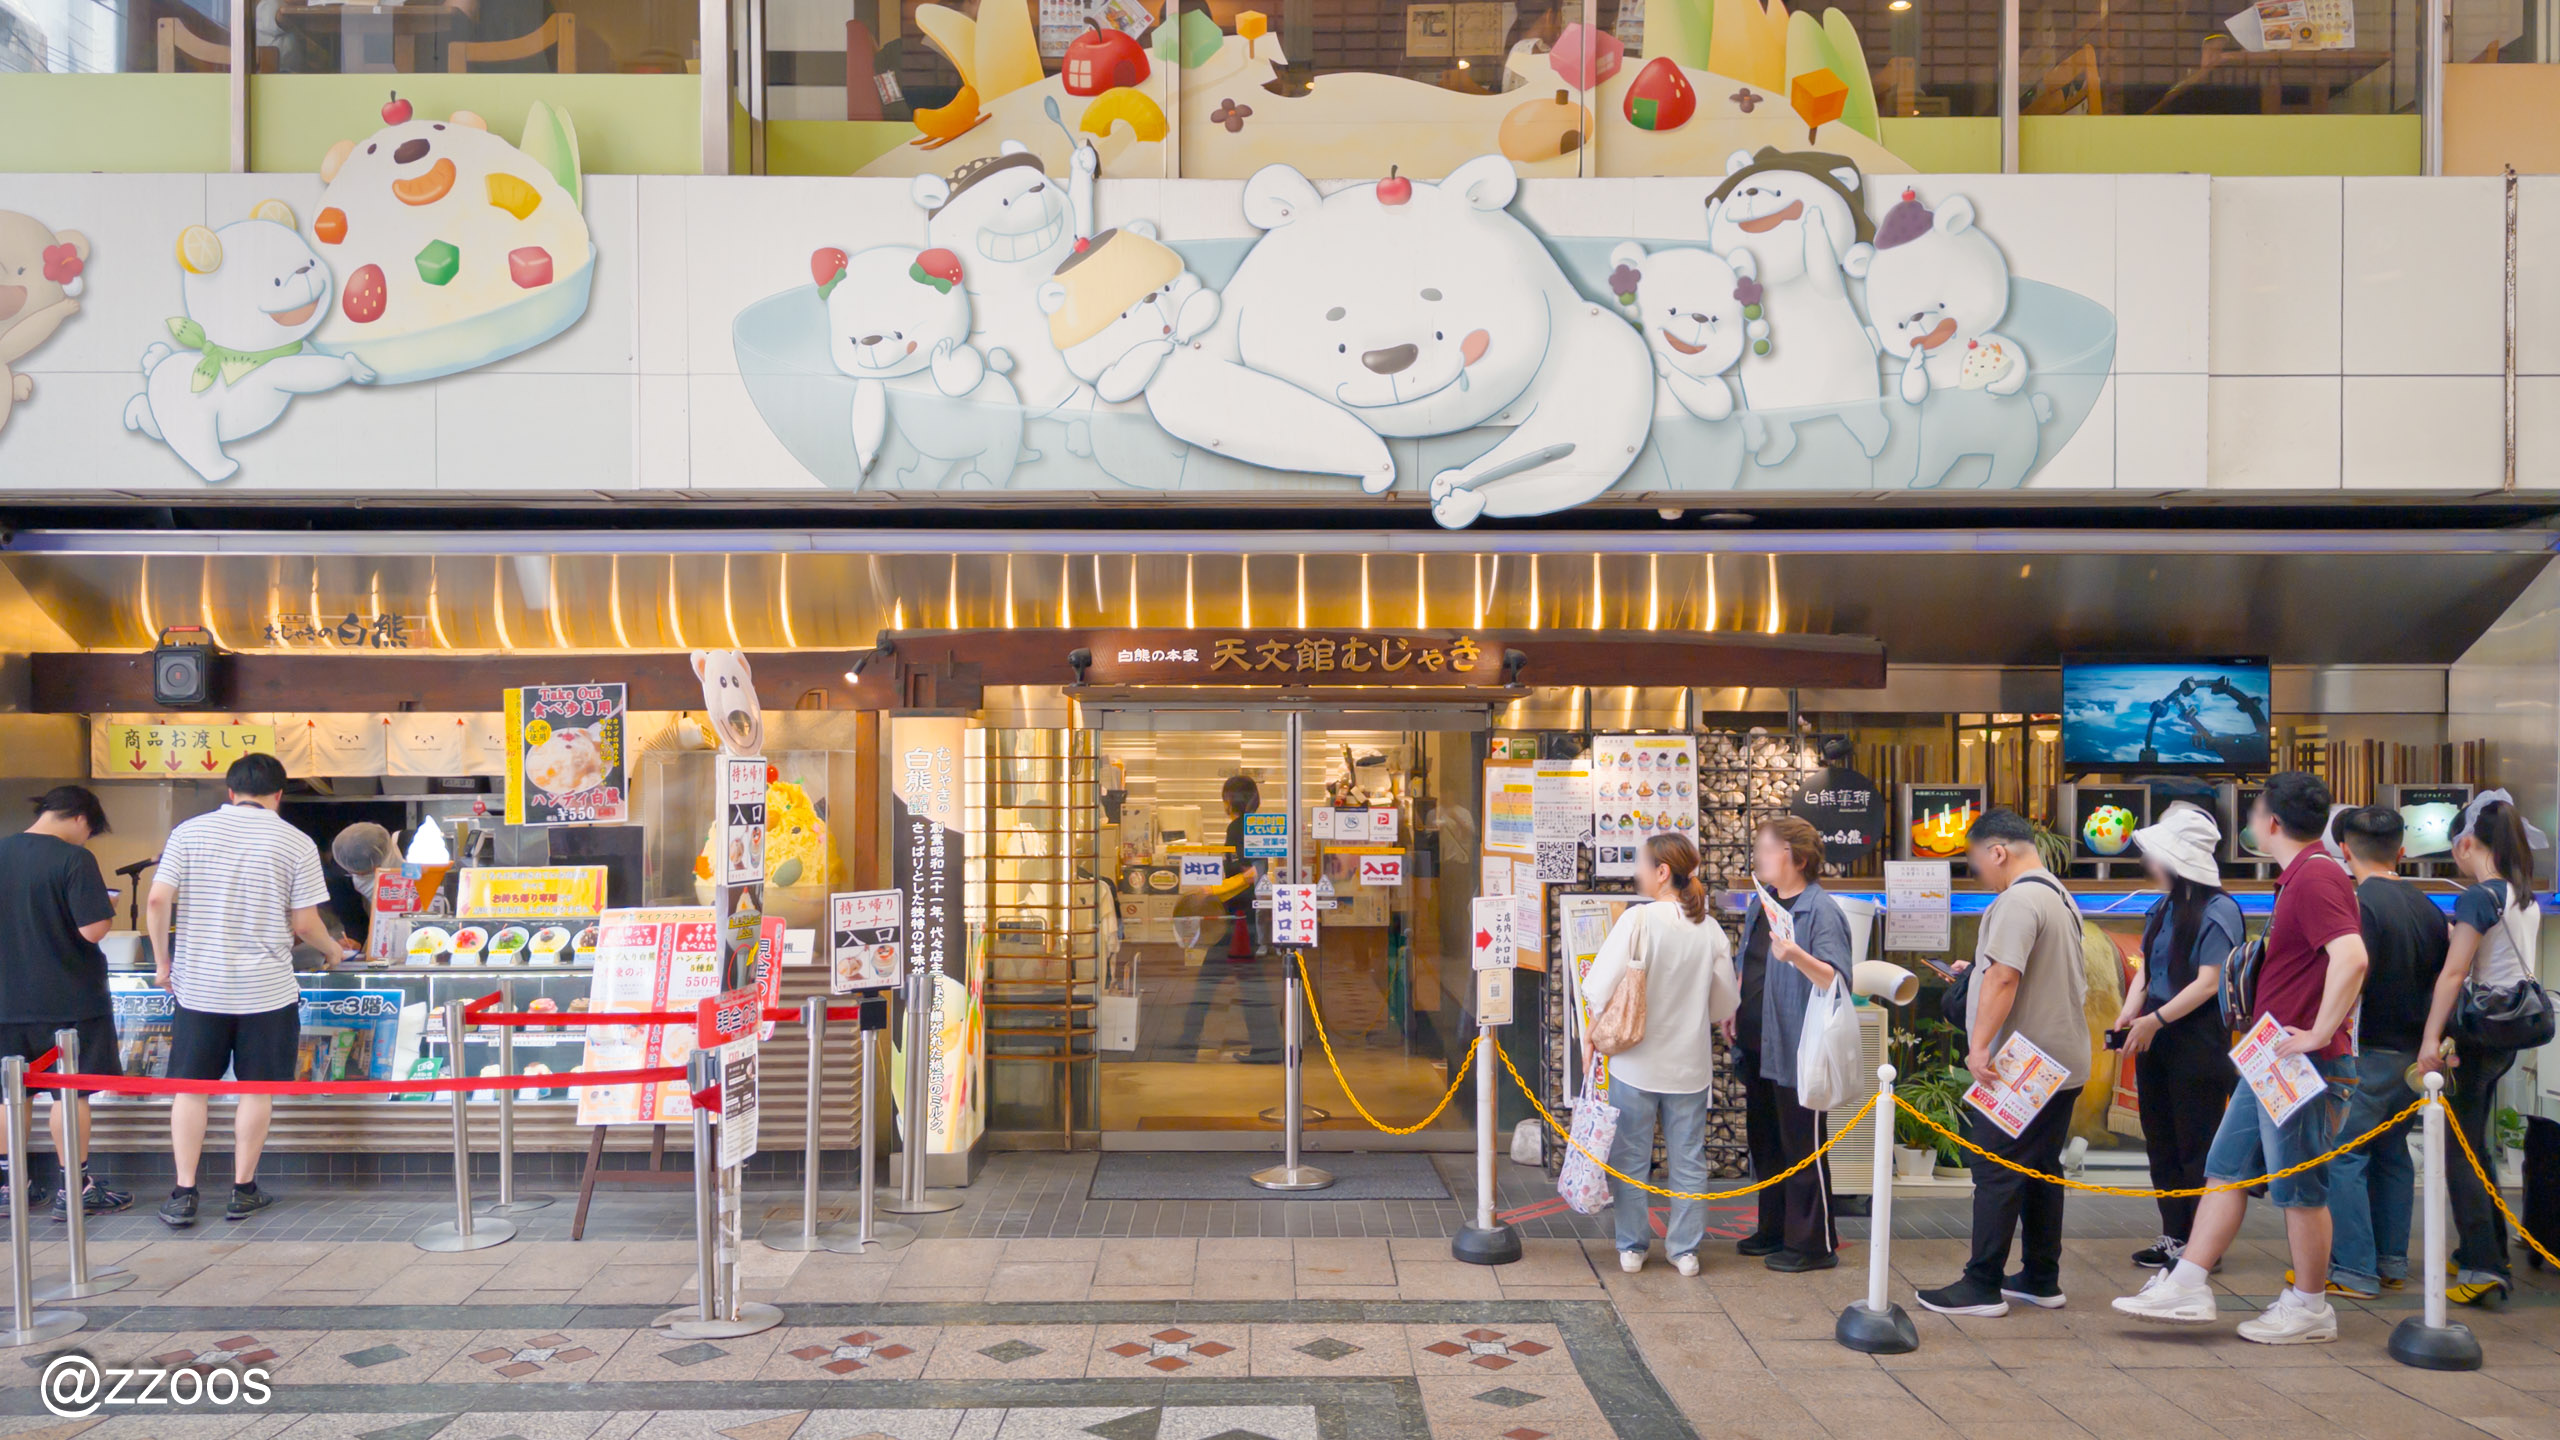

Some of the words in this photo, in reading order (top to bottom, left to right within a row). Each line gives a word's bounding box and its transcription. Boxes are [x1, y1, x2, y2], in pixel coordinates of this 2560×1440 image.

[1117, 648, 1199, 663] 白熊の本家
[1210, 636, 1480, 672] 天文館むじゃき
[538, 686, 574, 701] Take
[577, 686, 604, 700] Out
[531, 700, 613, 719] 食べ歩き用
[125, 729, 257, 750] 商品お渡し口
[732, 764, 763, 783] 持ち帰り
[904, 747, 933, 792] 白熊
[937, 746, 951, 813] むじゃきの
[531, 787, 620, 807] ハンディ白熊
[733, 787, 763, 801] コーナー
[557, 806, 595, 821] ¥550
[732, 804, 763, 824] 入口
[1246, 826, 1286, 834] しています
[1184, 862, 1220, 875] 出口
[1363, 862, 1400, 876] 入口
[840, 898, 894, 915] 持ち帰り
[1278, 900, 1292, 931] 出口
[1301, 900, 1314, 931] 入口
[842, 915, 896, 929] コーナー
[841, 927, 895, 947] 入口
[1495, 913, 1503, 965] こちらから
[1503, 911, 1512, 964] 店内入口は
[685, 976, 720, 989] 550円
